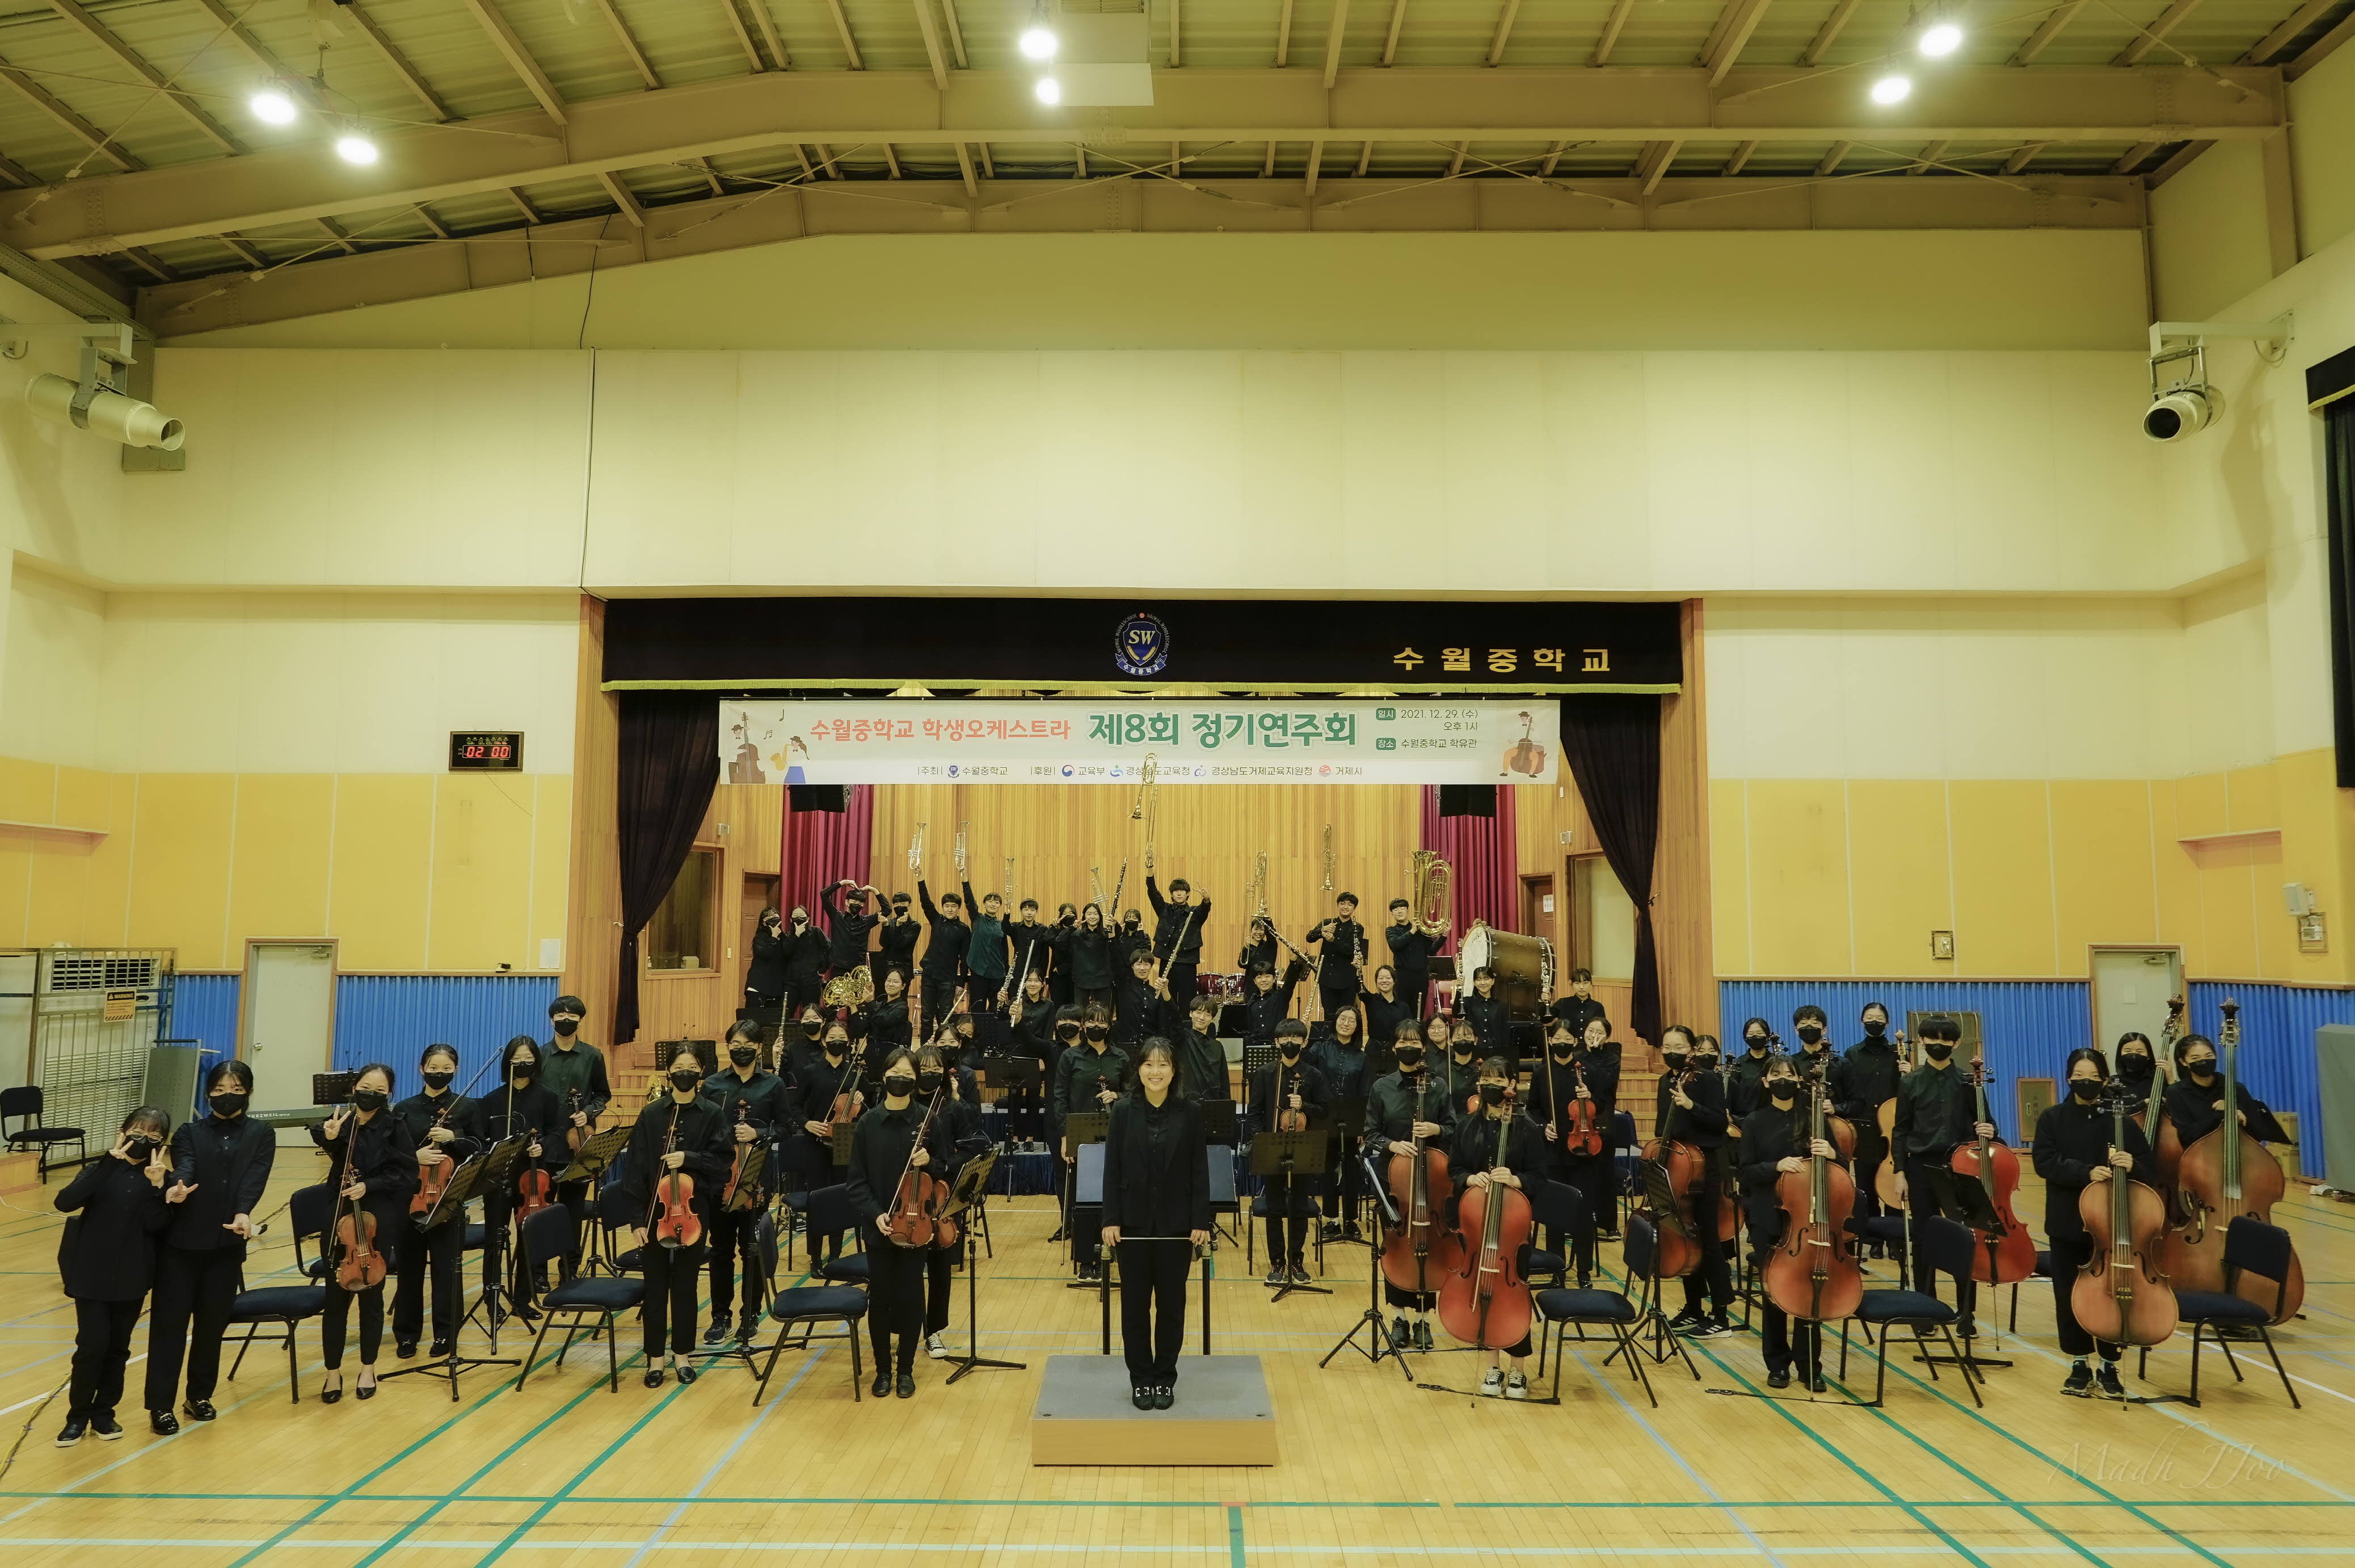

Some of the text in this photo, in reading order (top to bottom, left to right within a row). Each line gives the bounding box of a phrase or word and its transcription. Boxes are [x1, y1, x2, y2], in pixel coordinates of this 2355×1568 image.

[1128, 630, 1156, 645] SW
[1393, 647, 1610, 673] 수월중학교
[1377, 709, 1478, 719] 일시 2021. 12. 29. (수)
[810, 711, 1355, 748] 수월중학교 학생오케스트라 제8회 정기연주회
[1444, 722, 1478, 731] 오후 1시
[1377, 739, 1477, 748] 장소 수월중학교 학유관
[962, 766, 1008, 776] 수월중학교
[1077, 766, 1106, 776] 교육부
[1126, 766, 1190, 775] 경상도교육청
[1211, 766, 1313, 776] 경상남도거제교육지원청
[1335, 766, 1363, 776] 거제시
